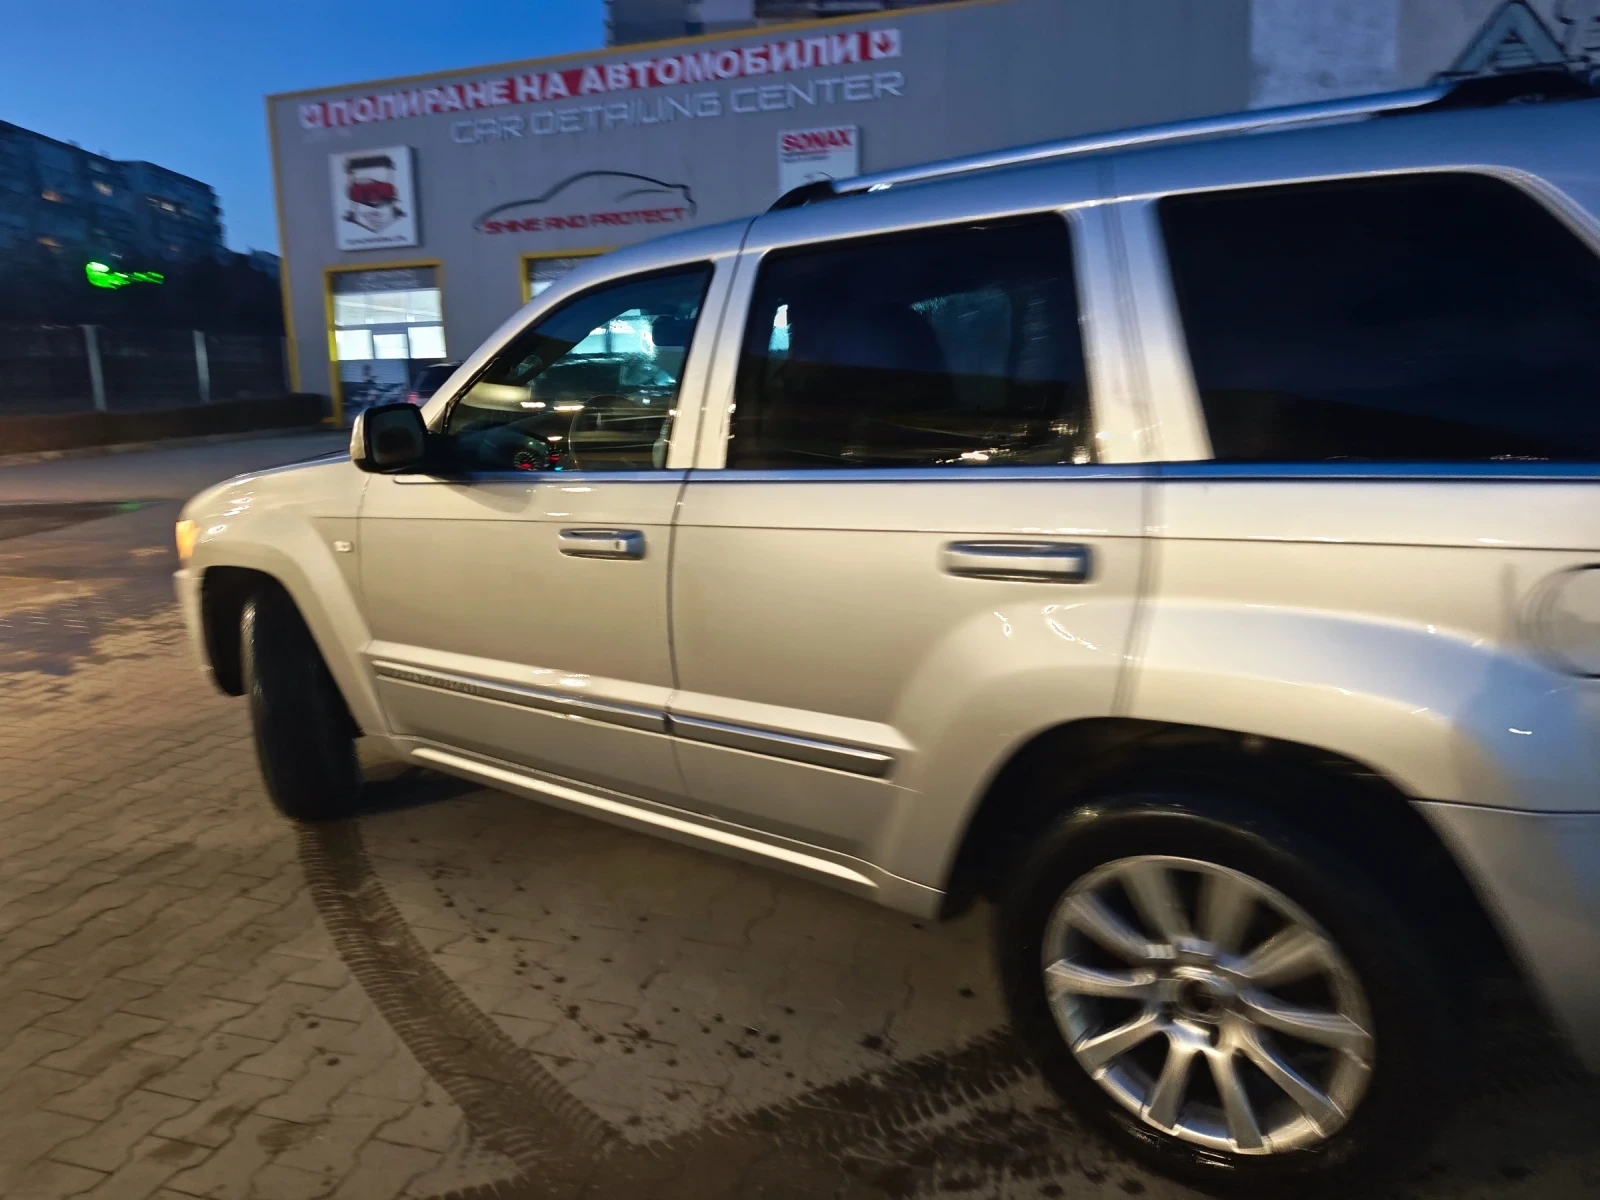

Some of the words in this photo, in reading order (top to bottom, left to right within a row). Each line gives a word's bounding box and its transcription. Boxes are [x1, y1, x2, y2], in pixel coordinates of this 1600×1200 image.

[327, 80, 510, 127] ПОЛИРАНЕ
[513, 72, 570, 102] НА
[577, 33, 860, 95] АВТОМОБИЛИ
[452, 115, 524, 144] CAR
[730, 71, 905, 114] CENTER
[781, 128, 852, 152] SONAX
[589, 206, 687, 228] PROTECT
